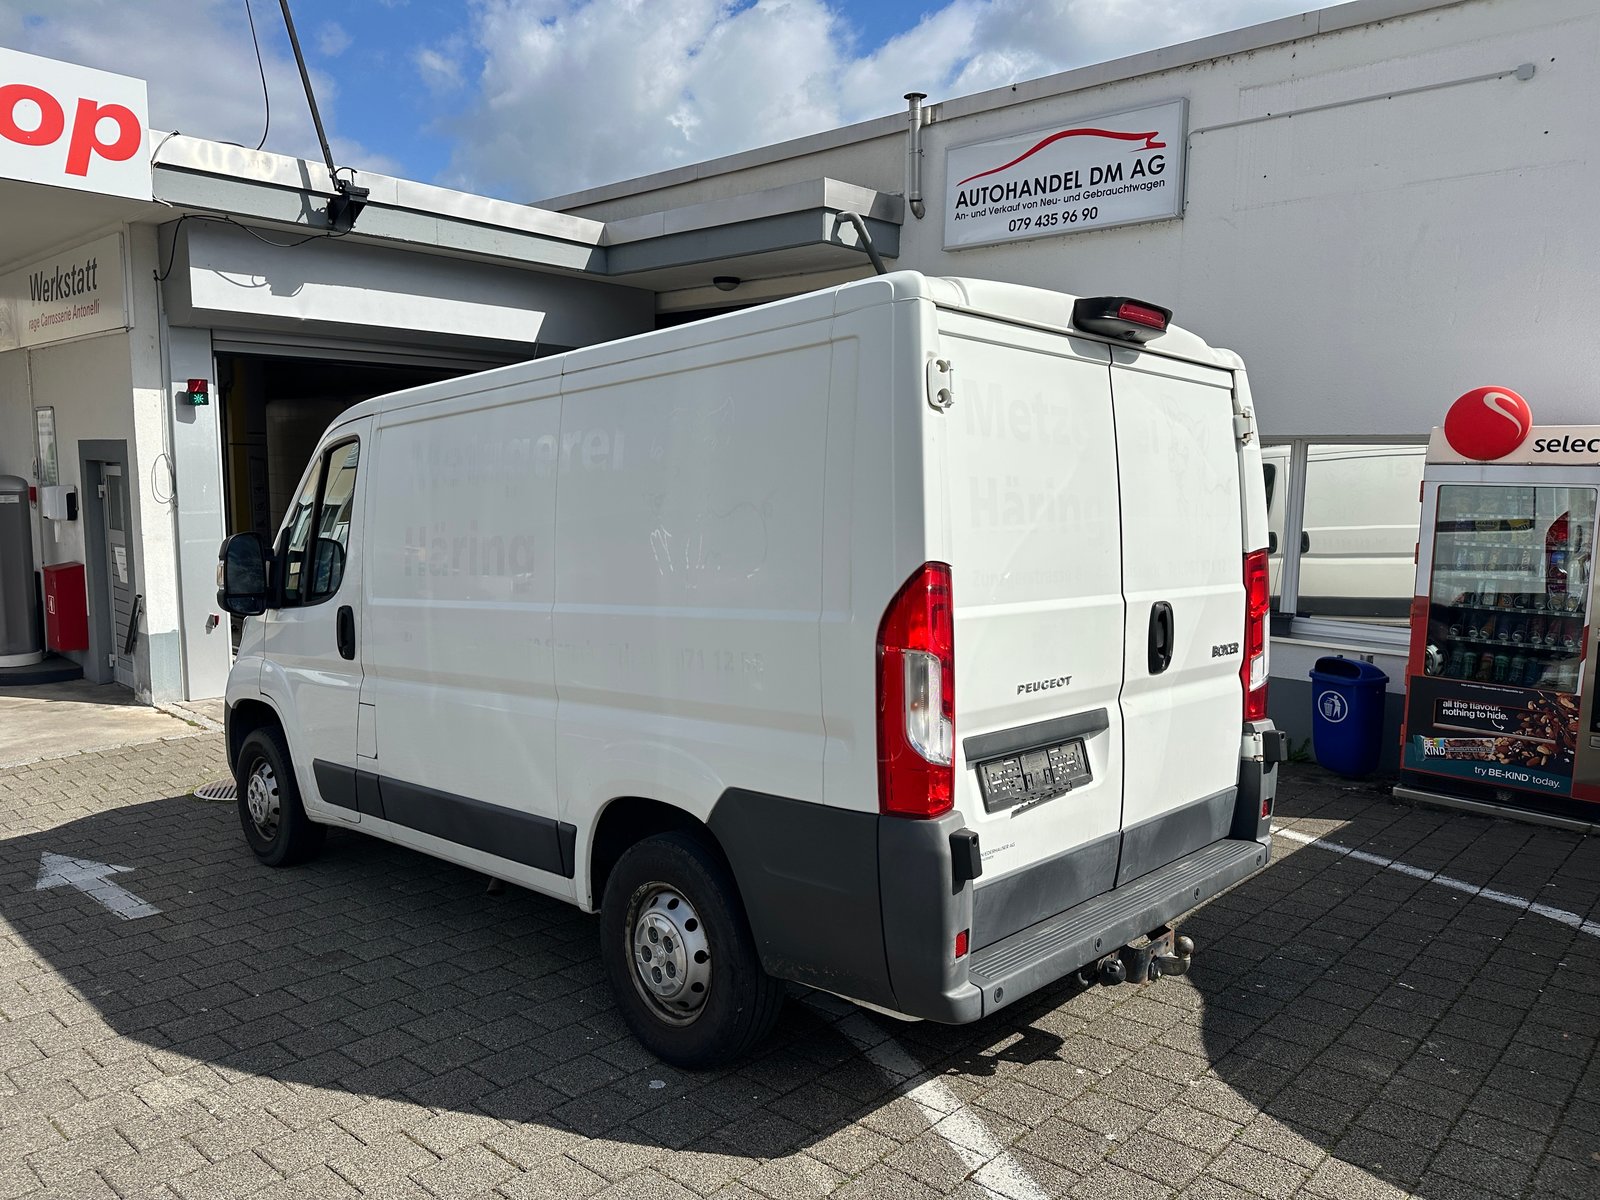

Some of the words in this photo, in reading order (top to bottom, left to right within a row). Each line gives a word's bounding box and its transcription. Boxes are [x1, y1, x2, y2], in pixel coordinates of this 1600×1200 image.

[0, 84, 142, 177] op
[955, 170, 1082, 209] AUTOHANDEL
[1089, 162, 1123, 186] DM
[1130, 154, 1166, 180] AG
[954, 211, 969, 221] An-
[970, 208, 987, 219] und
[988, 202, 1021, 216] Verkauf
[1022, 202, 1038, 210] von
[1040, 197, 1061, 208] Neu-
[1063, 191, 1081, 203] und
[1082, 179, 1165, 200] Gebrauchtwagen
[1008, 216, 1031, 232] 079
[1034, 212, 1058, 228] 435
[1061, 209, 1078, 223] 96
[1081, 206, 1098, 221] 90
[29, 257, 97, 302] Werkstatt
[40, 307, 72, 327] Carrosserie
[72, 298, 100, 320] Antonelli
[1532, 435, 1600, 453] selec
[1211, 642, 1239, 658] BOXER
[1017, 675, 1072, 695] PEUGEOT
[1442, 700, 1453, 708] all
[1453, 700, 1468, 709] the
[1442, 708, 1475, 719] nothing
[1476, 710, 1486, 718] to
[1487, 711, 1509, 720] hide.
[1424, 746, 1446, 756] KIND
[1474, 766, 1487, 776] try
[1488, 768, 1529, 782] BE-KIND
[1532, 776, 1560, 789] today.
